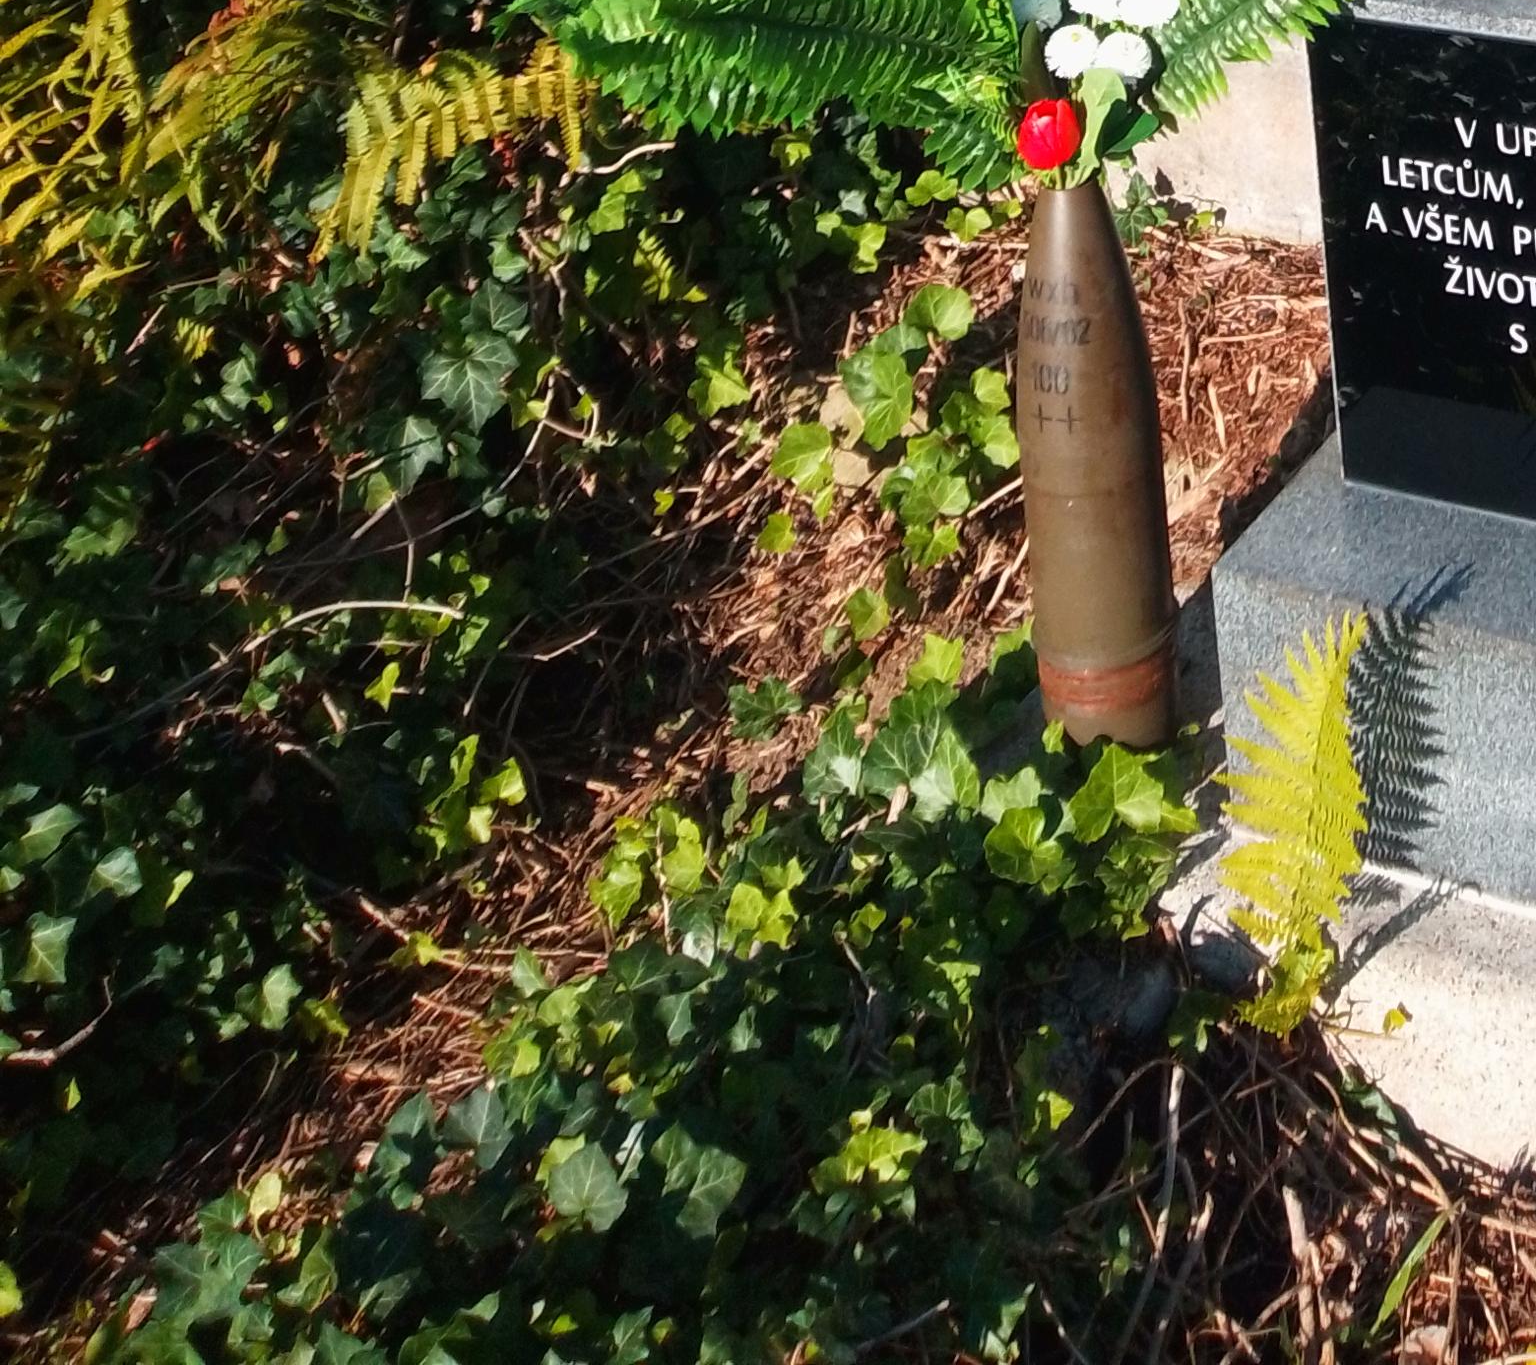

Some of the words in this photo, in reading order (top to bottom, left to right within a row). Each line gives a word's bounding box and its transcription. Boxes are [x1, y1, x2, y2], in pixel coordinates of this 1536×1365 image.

[1454, 116, 1478, 148] V
[1381, 154, 1524, 210] LETCŮM,
[1365, 201, 1388, 233] A
[1401, 202, 1494, 251] VŠEM
[1509, 323, 1529, 355] S
